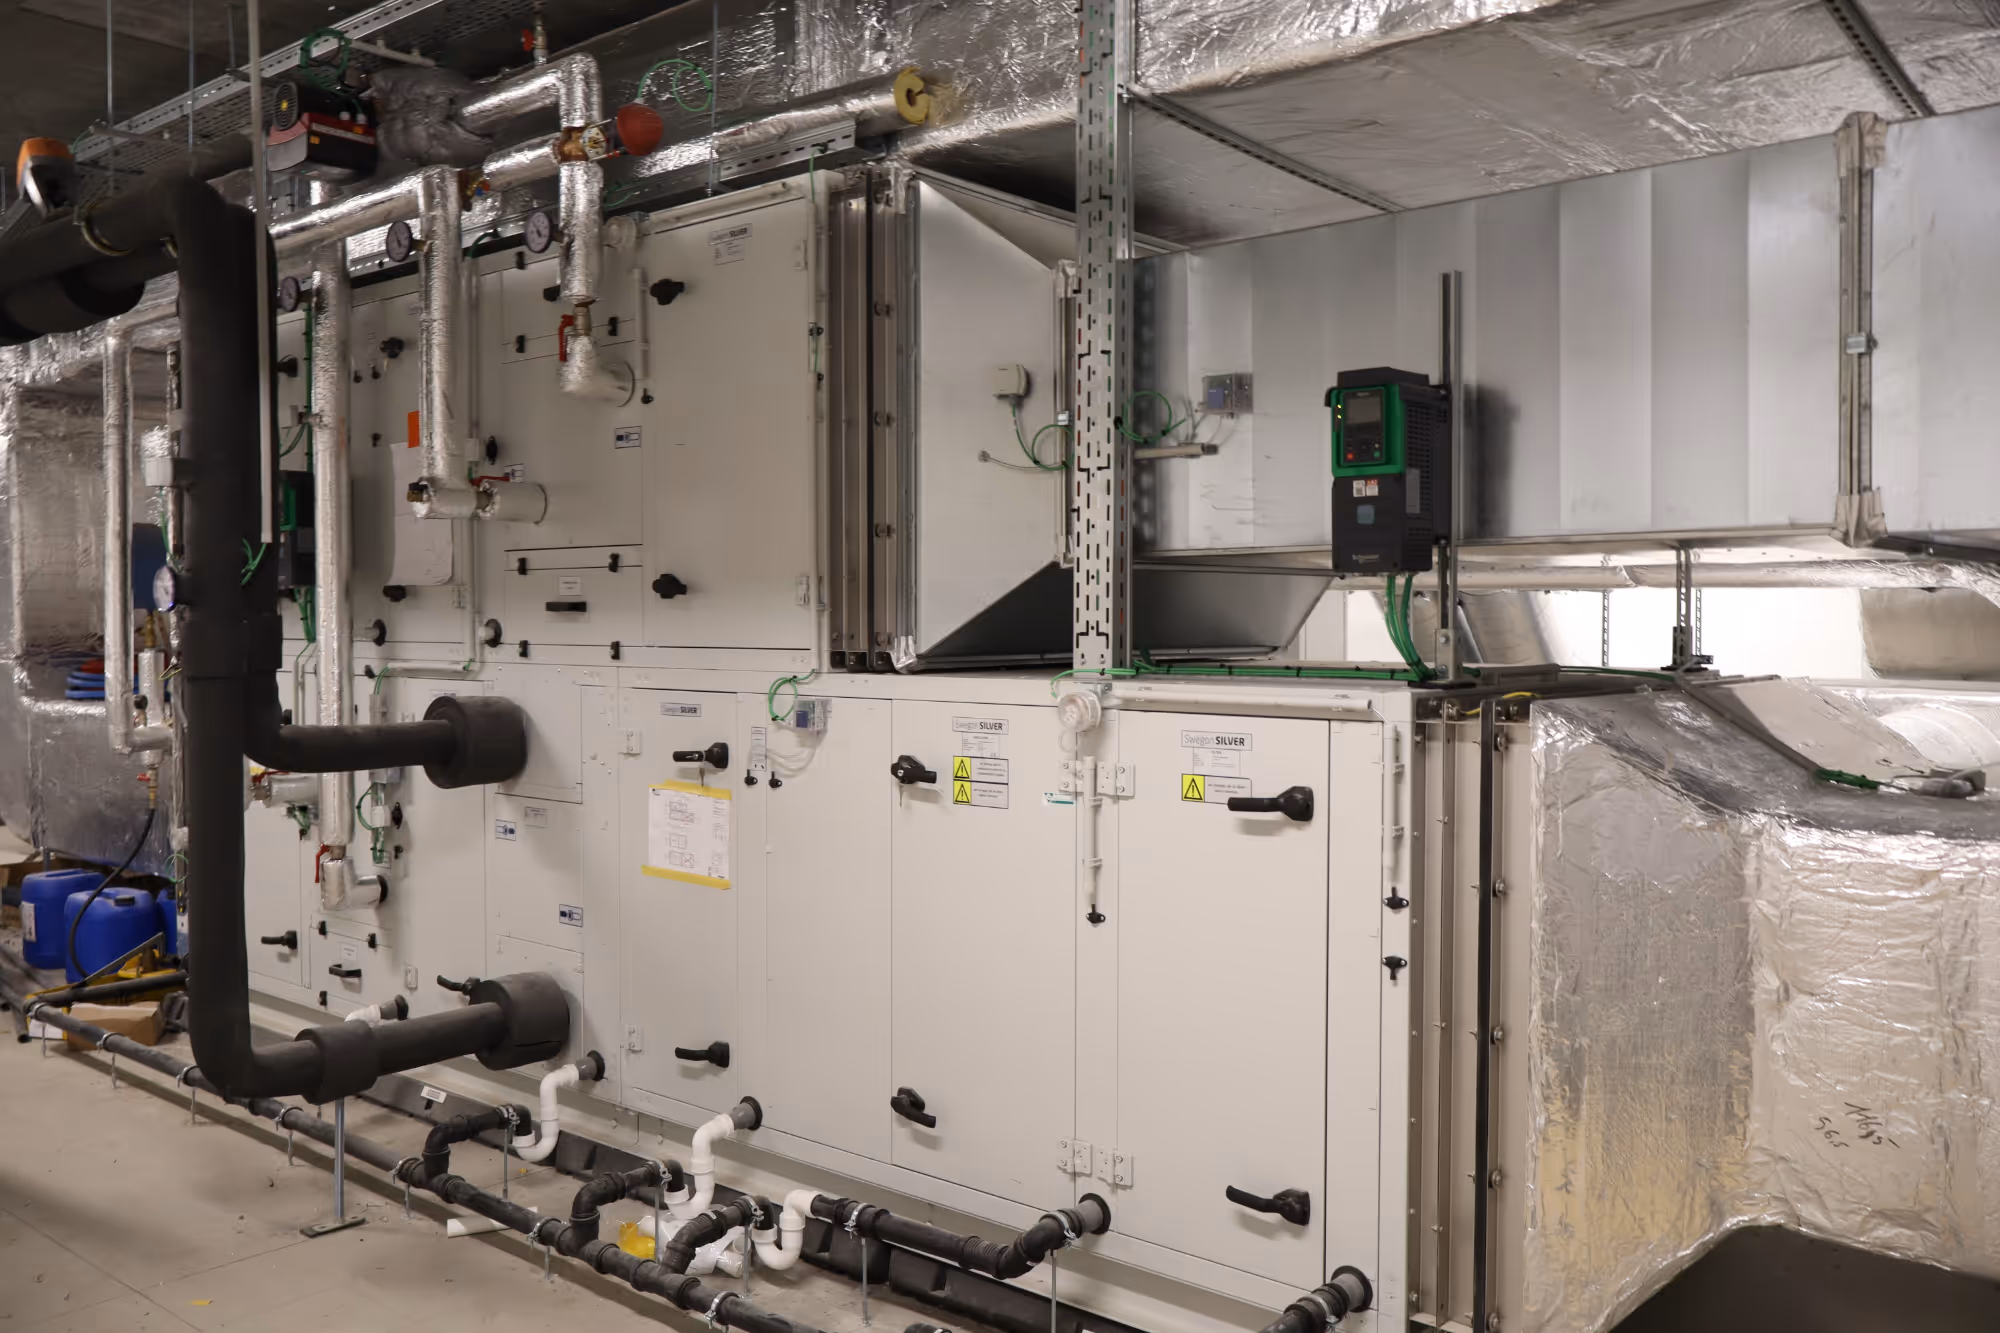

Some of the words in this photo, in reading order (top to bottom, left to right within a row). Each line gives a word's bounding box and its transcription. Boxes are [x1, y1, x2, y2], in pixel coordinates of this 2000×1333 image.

[979, 721, 1003, 731] SILVER
[1184, 734, 1215, 746] Swegon
[1215, 736, 1245, 747] SILVER
